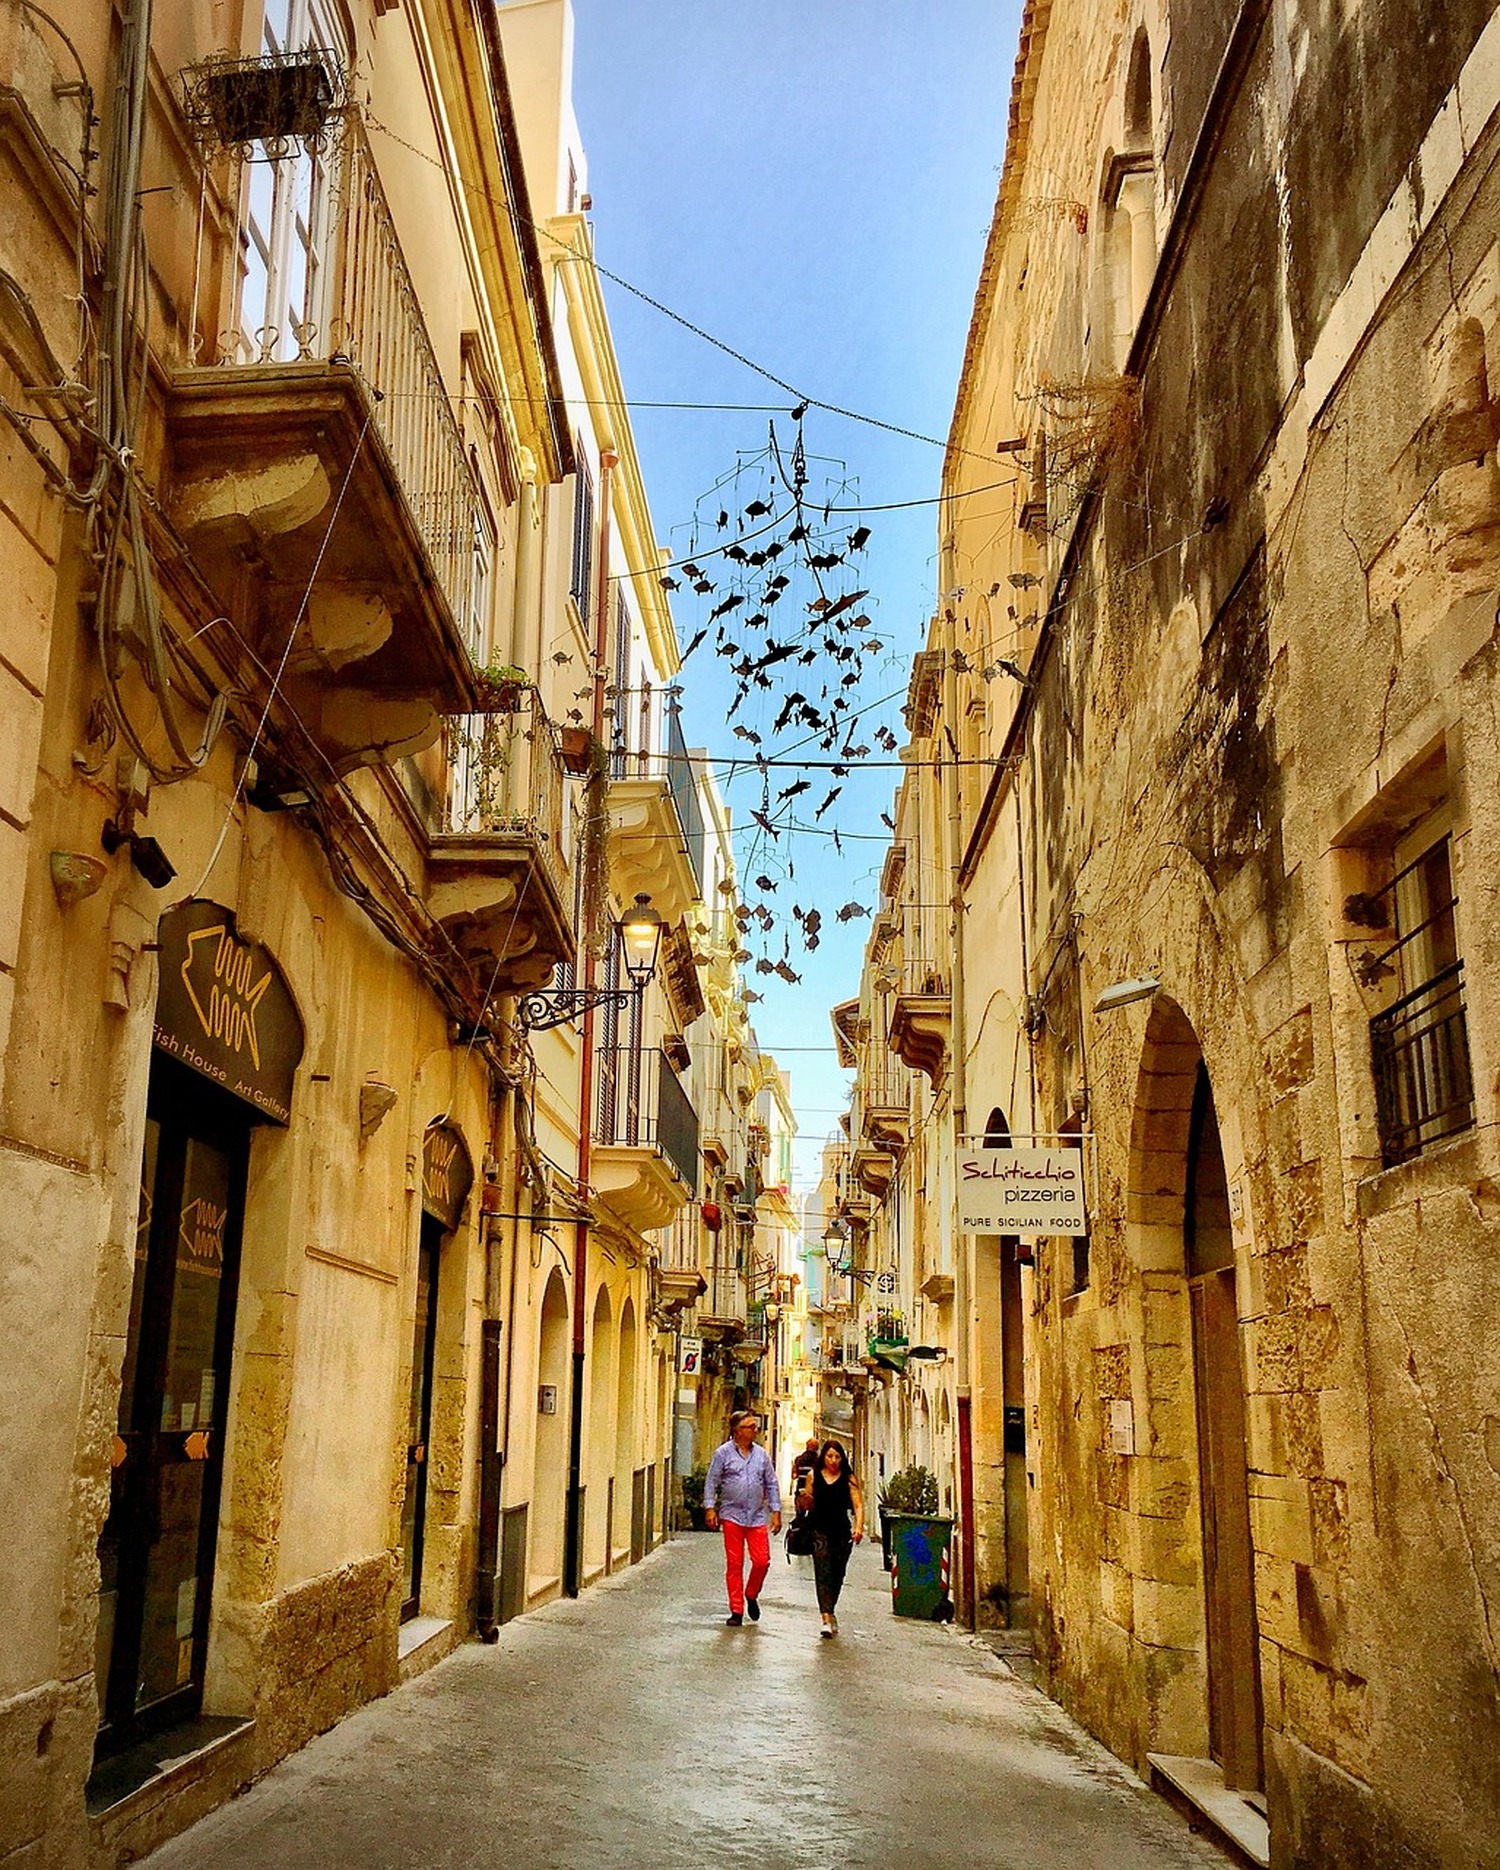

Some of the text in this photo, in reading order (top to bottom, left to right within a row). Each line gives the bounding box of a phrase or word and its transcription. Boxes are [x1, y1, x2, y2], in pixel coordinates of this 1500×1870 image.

[182, 1044, 227, 1081] House
[234, 1080, 290, 1120] Art Gallery
[962, 1157, 1075, 1181] Schiticchio
[1005, 1186, 1075, 1204] pizzeria
[963, 1217, 1081, 1228] PURE SICILIAN FOOD
